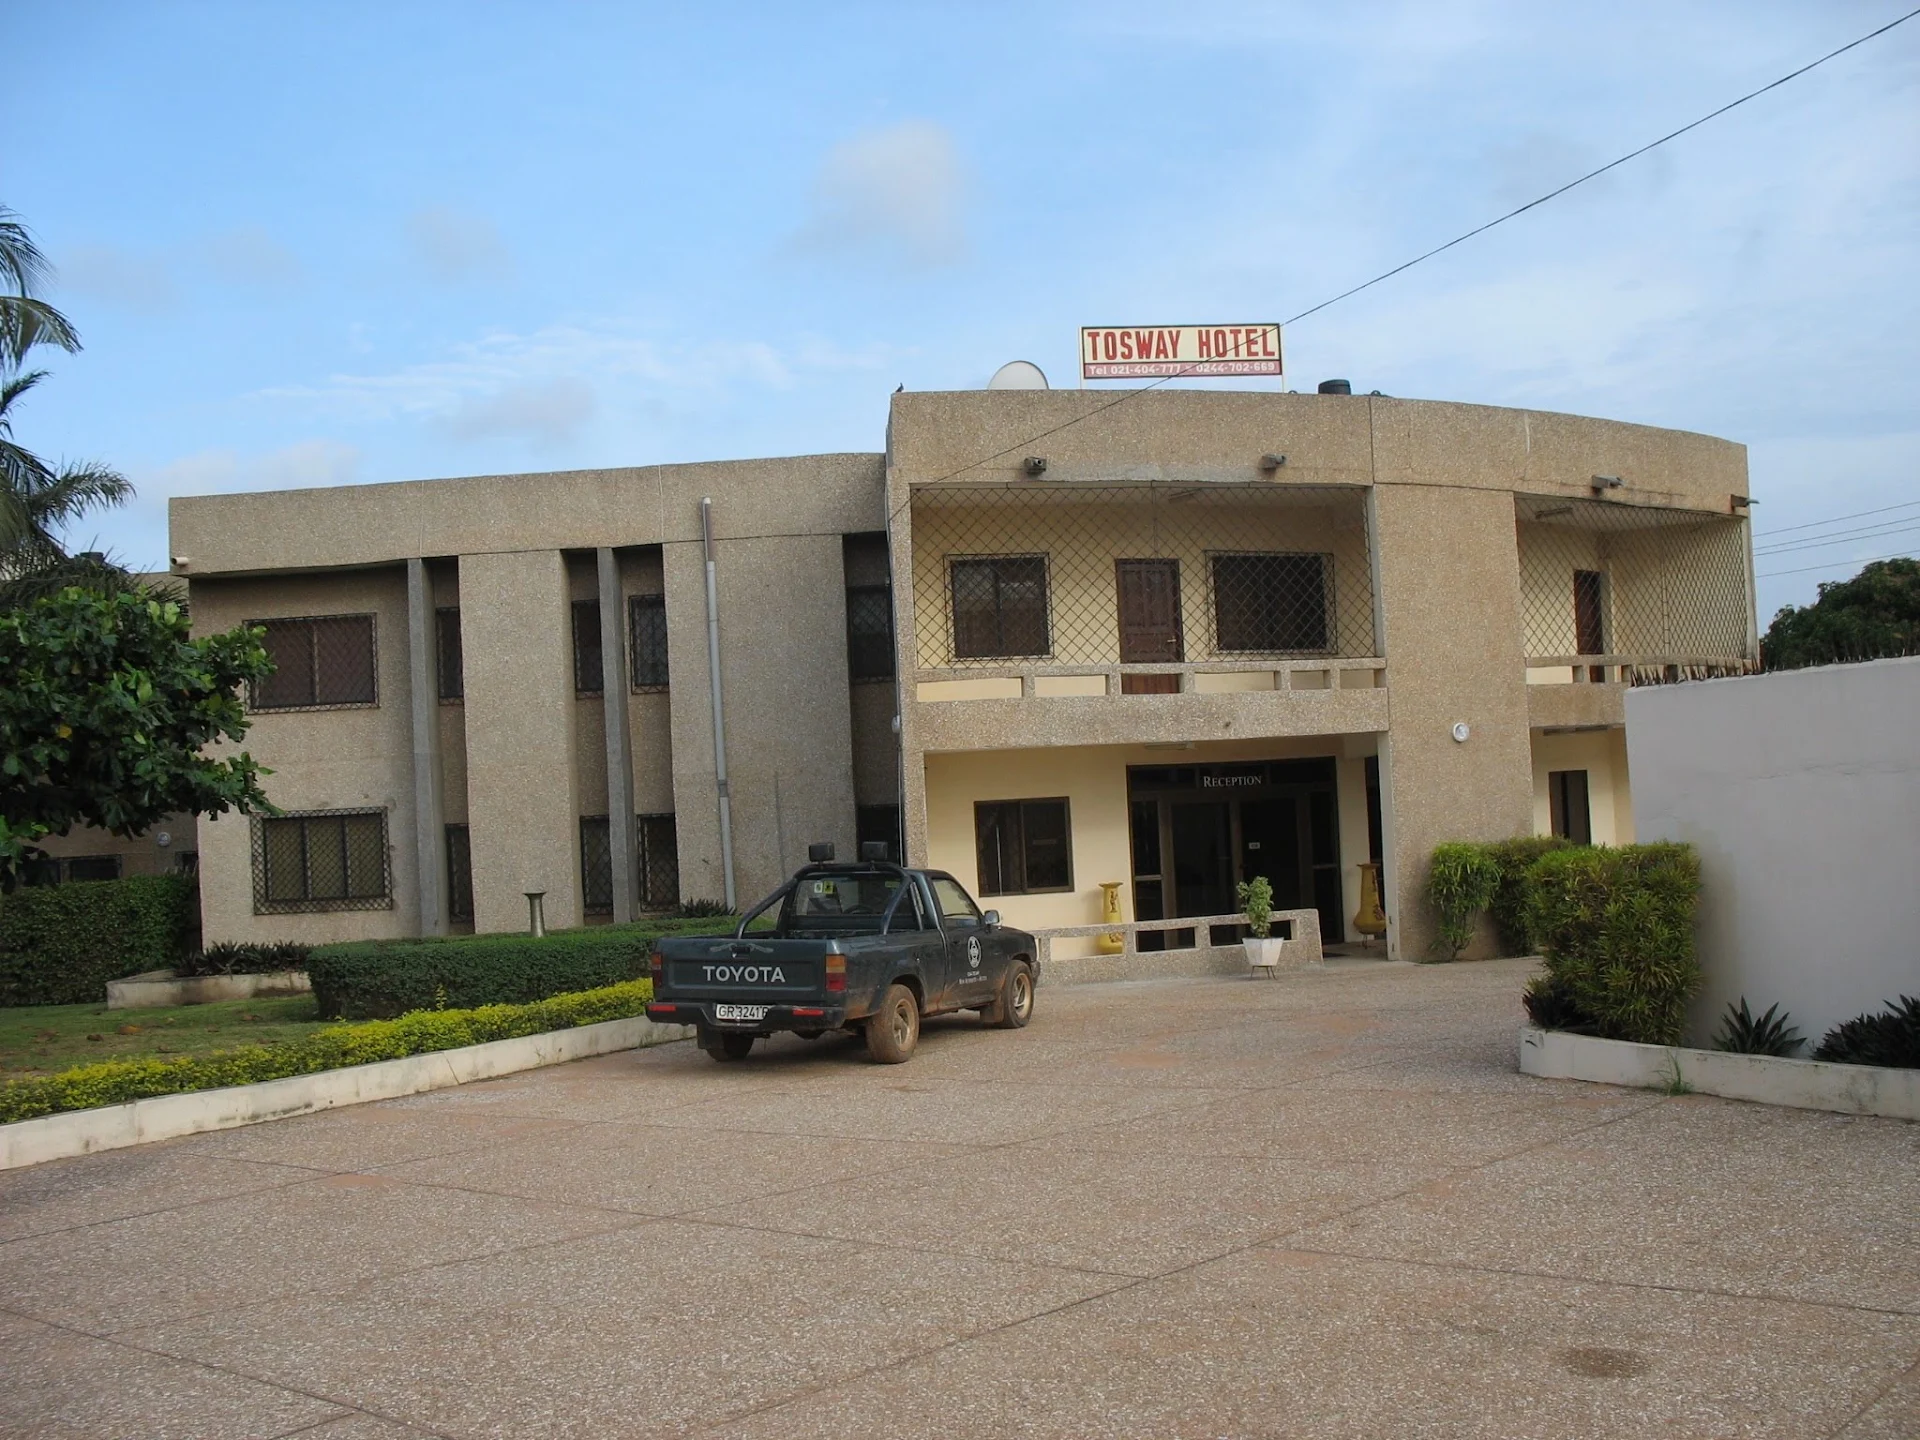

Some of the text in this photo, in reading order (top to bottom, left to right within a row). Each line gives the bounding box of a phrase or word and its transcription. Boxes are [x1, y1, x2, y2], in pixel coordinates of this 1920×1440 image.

[1087, 328, 1276, 360] TOSWAY HOTEL
[1203, 775, 1262, 788] RECEPTION
[702, 965, 786, 983] TOYOTA
